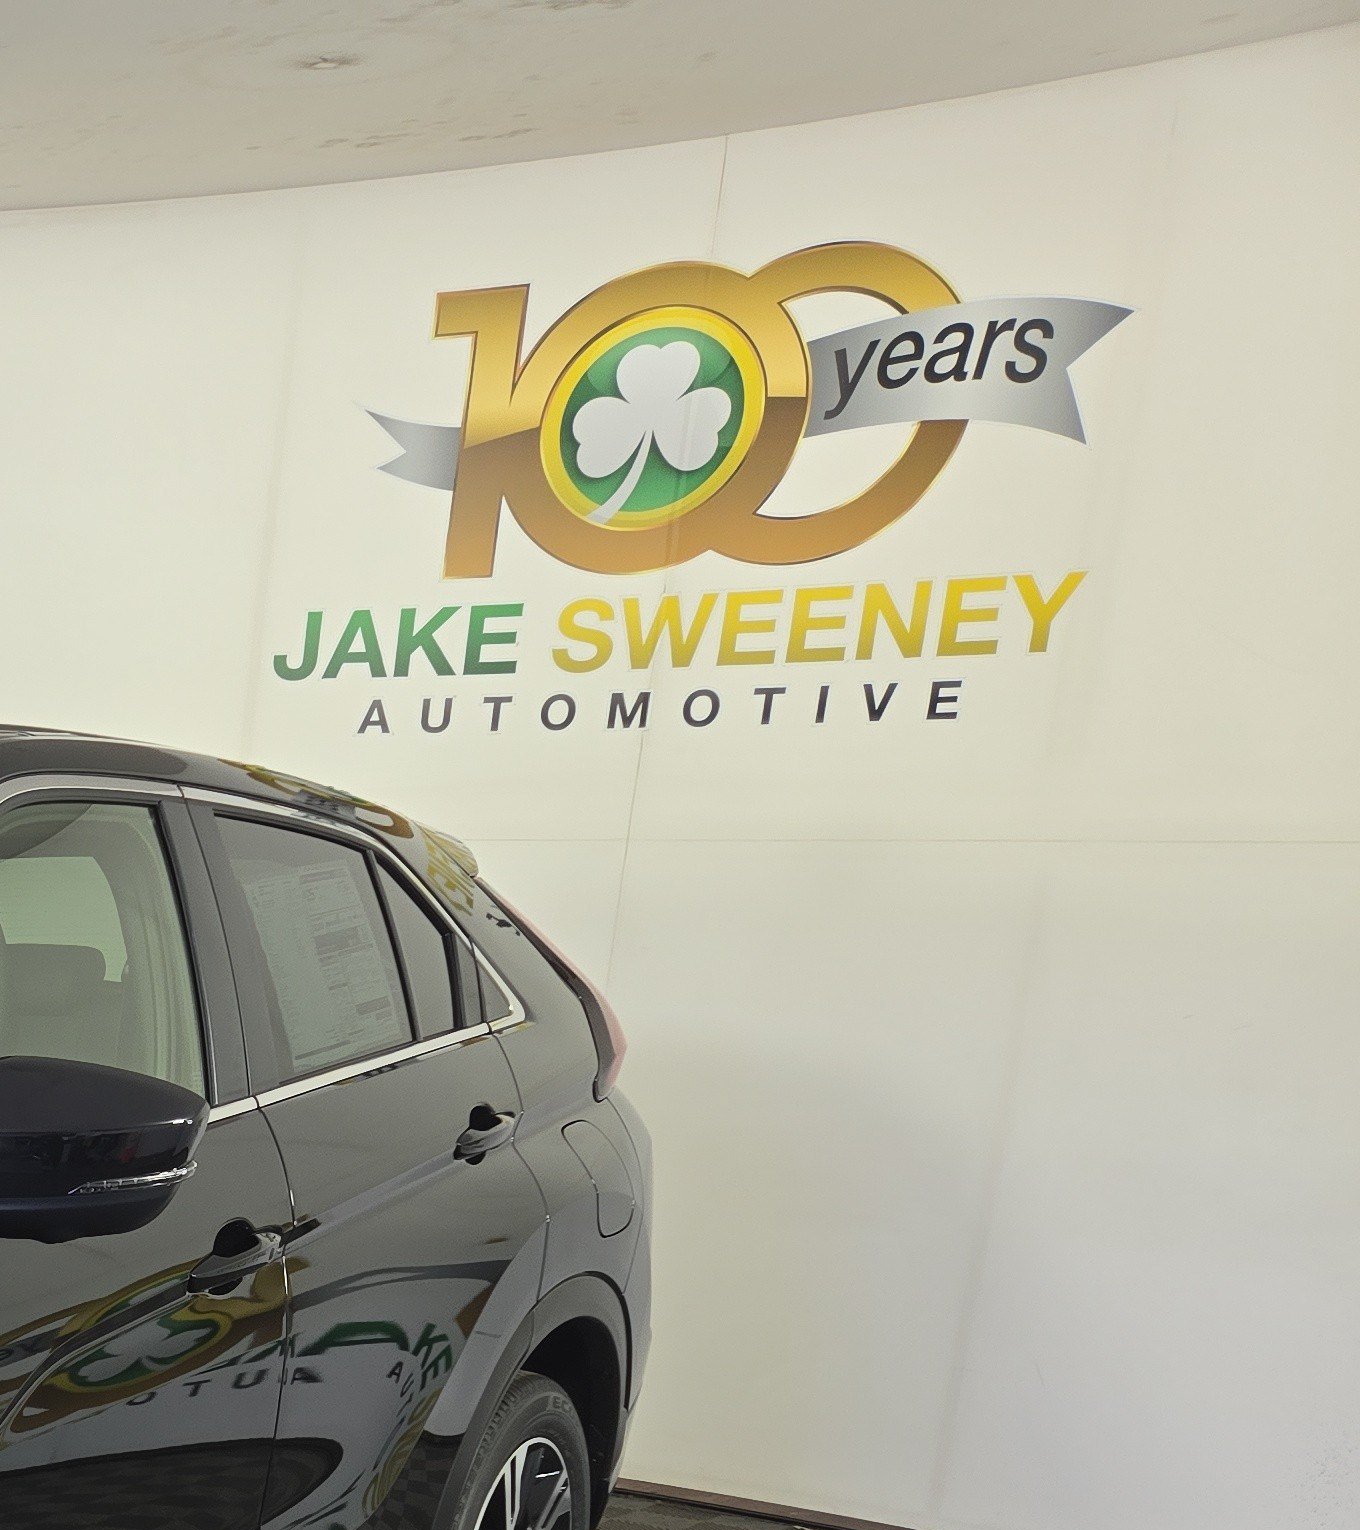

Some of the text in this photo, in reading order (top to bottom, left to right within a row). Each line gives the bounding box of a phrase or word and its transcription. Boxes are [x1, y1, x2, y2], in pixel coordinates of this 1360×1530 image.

[434, 241, 1054, 579] 100 years
[272, 570, 1090, 682] JAKE SWEENEY
[358, 679, 964, 736] AUTOMOTIVE
